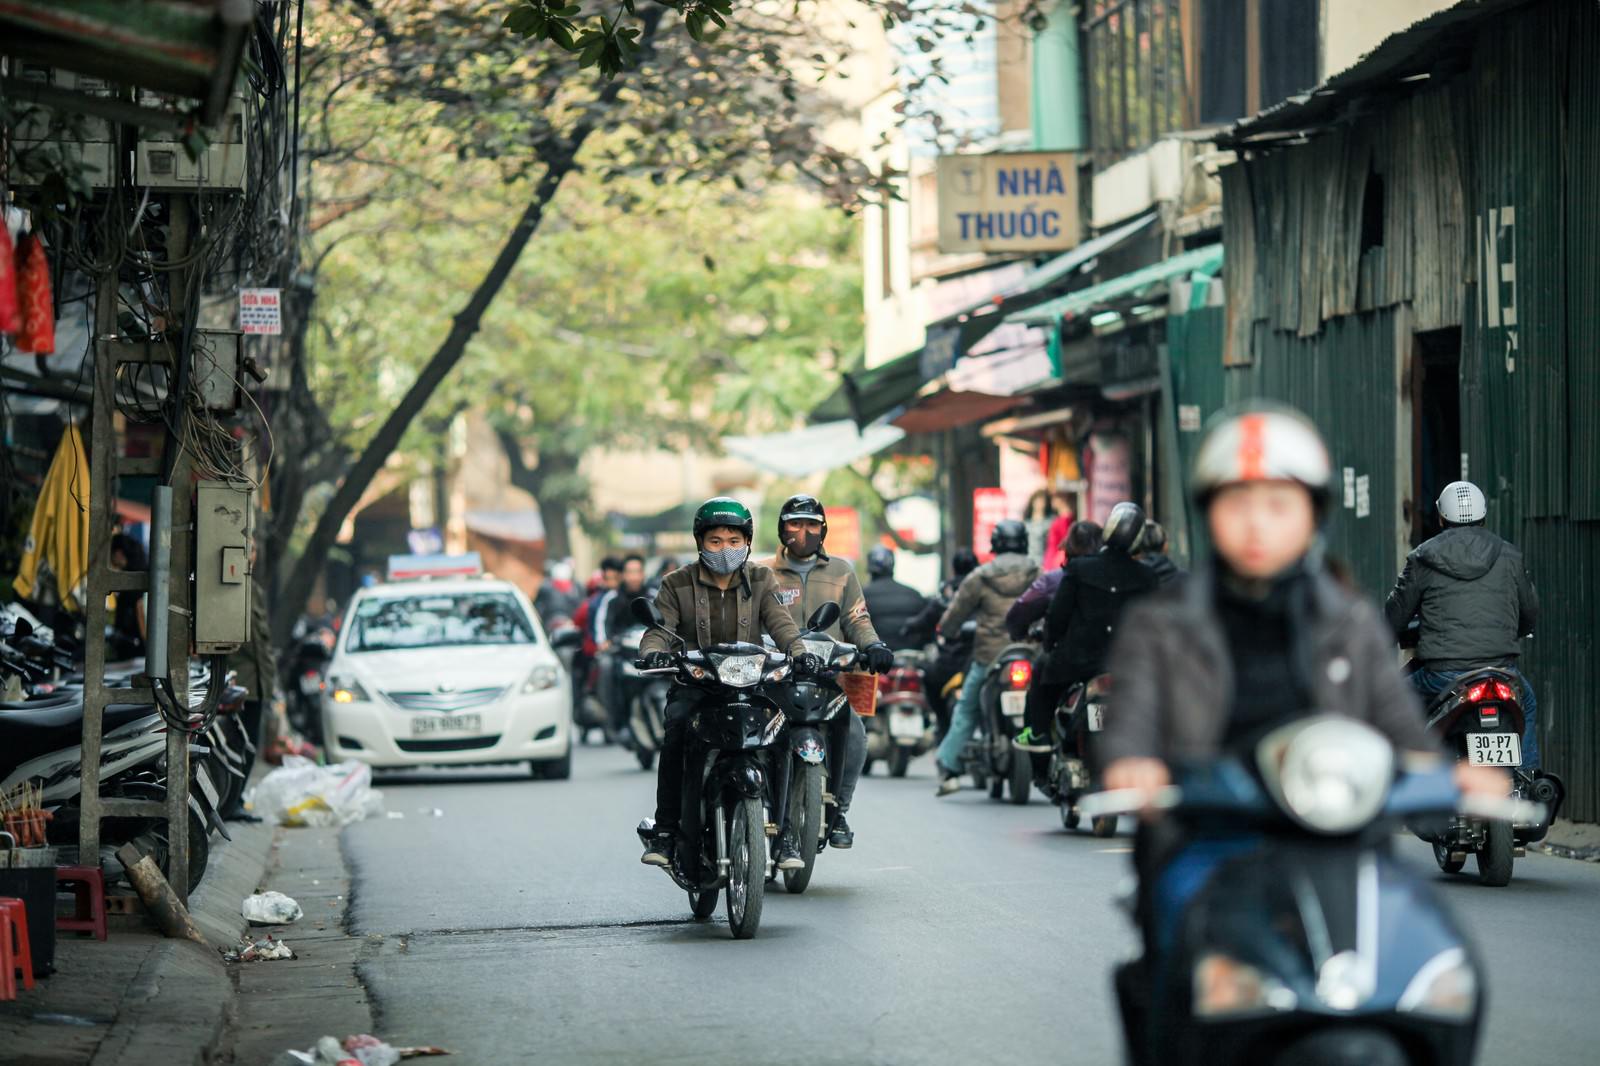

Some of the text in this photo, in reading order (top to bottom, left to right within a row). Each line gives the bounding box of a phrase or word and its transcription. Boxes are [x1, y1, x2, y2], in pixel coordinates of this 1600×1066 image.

[997, 161, 1065, 196] NHÀ
[957, 201, 1060, 241] THUỐC
[1475, 735, 1511, 749] 30-P7
[1476, 750, 1513, 763] 3421
